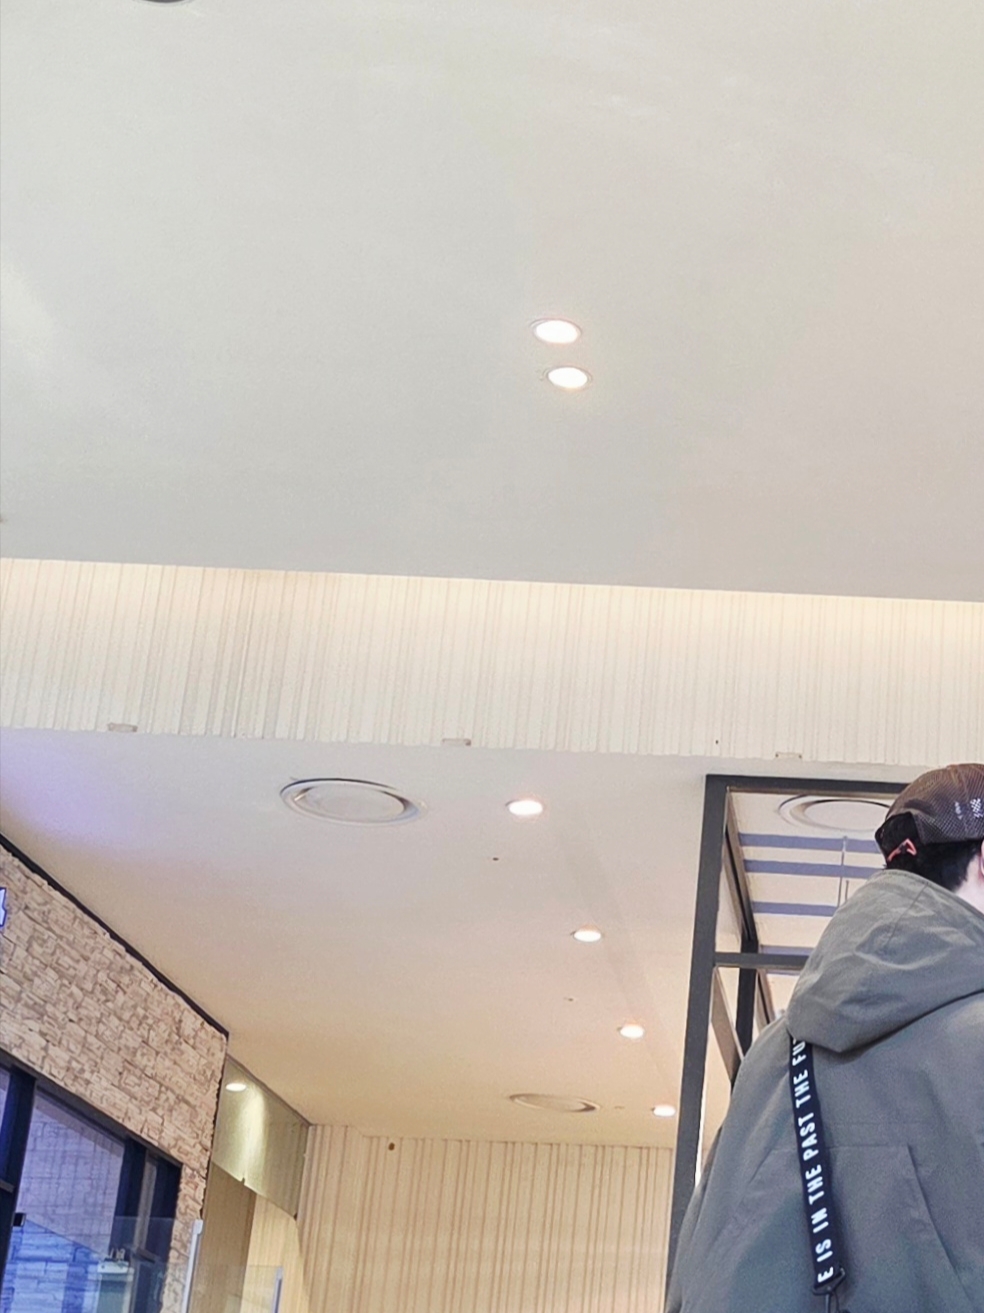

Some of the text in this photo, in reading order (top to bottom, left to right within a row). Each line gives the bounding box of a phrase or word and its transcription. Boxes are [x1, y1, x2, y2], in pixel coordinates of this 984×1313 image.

[793, 1069, 811, 1108] THE
[798, 1112, 819, 1161] PAST
[805, 1164, 825, 1205] THE
[811, 1207, 830, 1233] IN
[816, 1239, 833, 1262] IS
